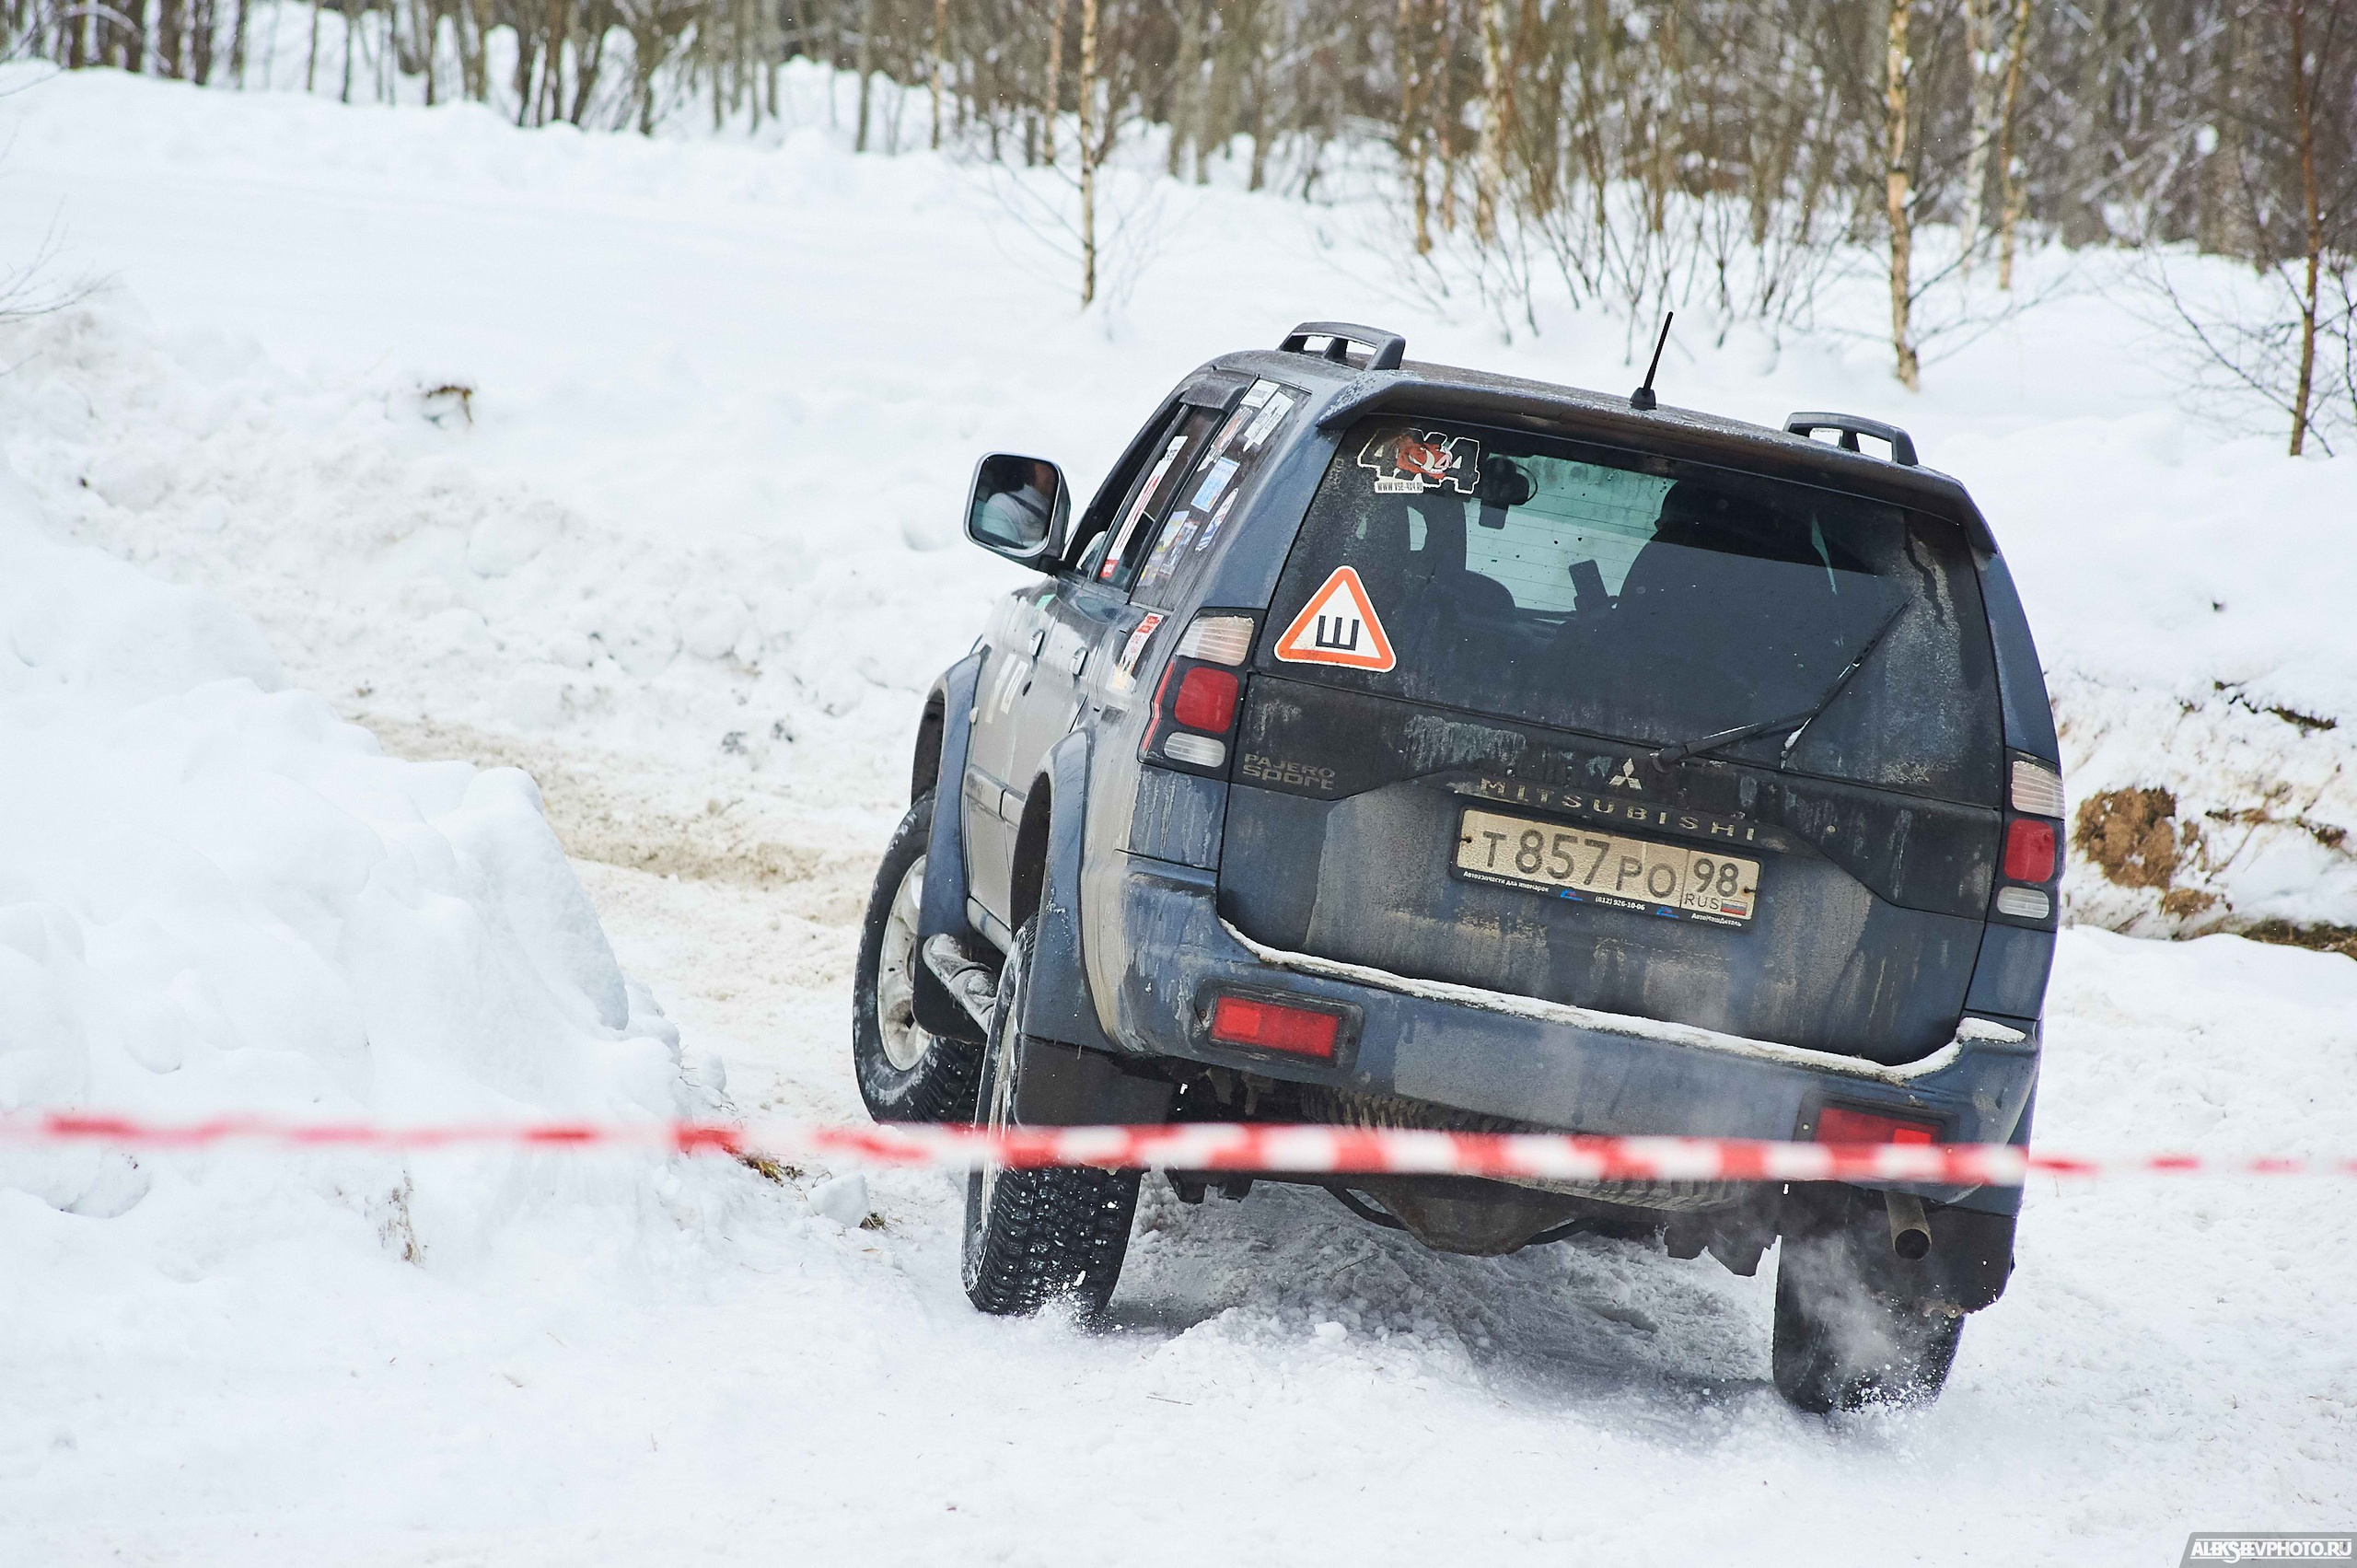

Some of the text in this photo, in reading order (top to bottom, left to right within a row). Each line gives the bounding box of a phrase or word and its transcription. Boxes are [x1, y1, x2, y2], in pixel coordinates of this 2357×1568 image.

[1243, 752, 1336, 778] PAJERO
[1480, 777, 1756, 842] MITSUBISHI
[1692, 857, 1739, 898] 98
[1684, 892, 1720, 910] RUS
